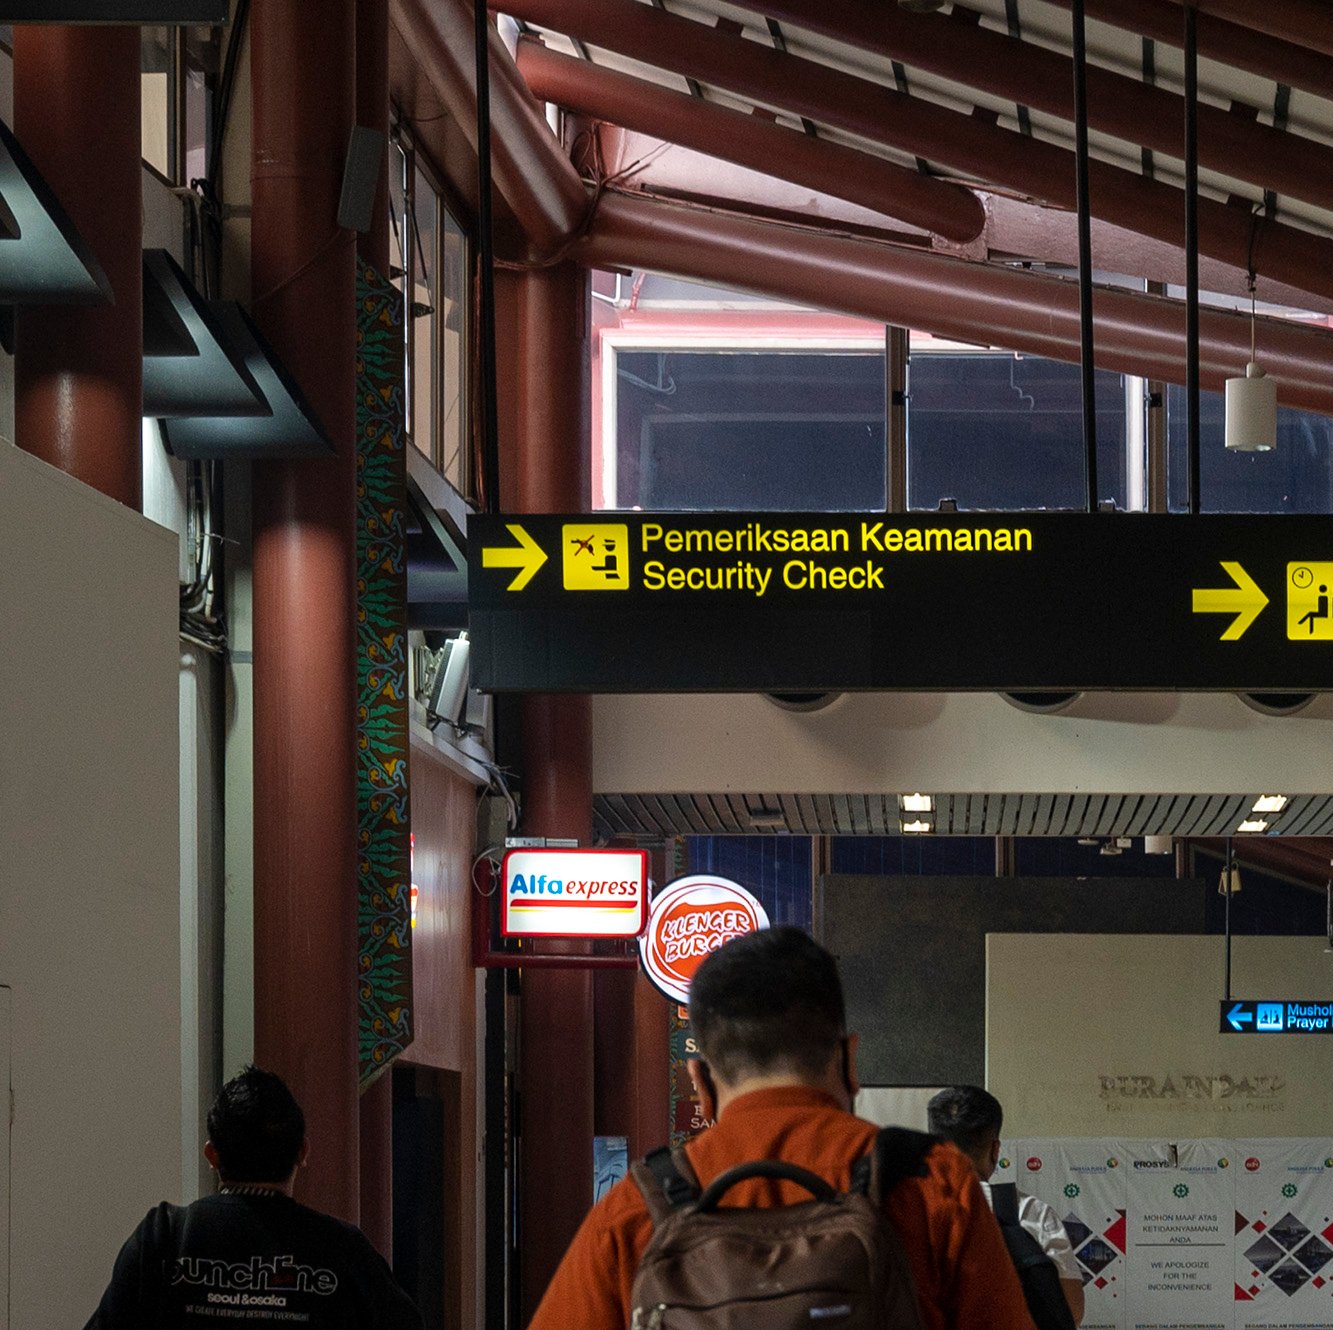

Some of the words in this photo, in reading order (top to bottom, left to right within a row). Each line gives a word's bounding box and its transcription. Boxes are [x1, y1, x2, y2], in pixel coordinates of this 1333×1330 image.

[641, 522, 849, 552] Pemeriksaan
[861, 522, 1033, 552] Keamanan
[643, 561, 772, 596] Security
[782, 561, 884, 590] Check
[510, 873, 562, 895] Alfa
[566, 878, 638, 899] express
[662, 909, 751, 942] KLENGER
[1287, 1017, 1329, 1031] Prayer
[1165, 1261, 1209, 1269] APOLOGIZE
[1163, 1272, 1180, 1280] FOR
[1182, 1272, 1197, 1280] THE
[1147, 1283, 1212, 1291] INCONVENIENCE
[207, 1292, 241, 1305] seoul
